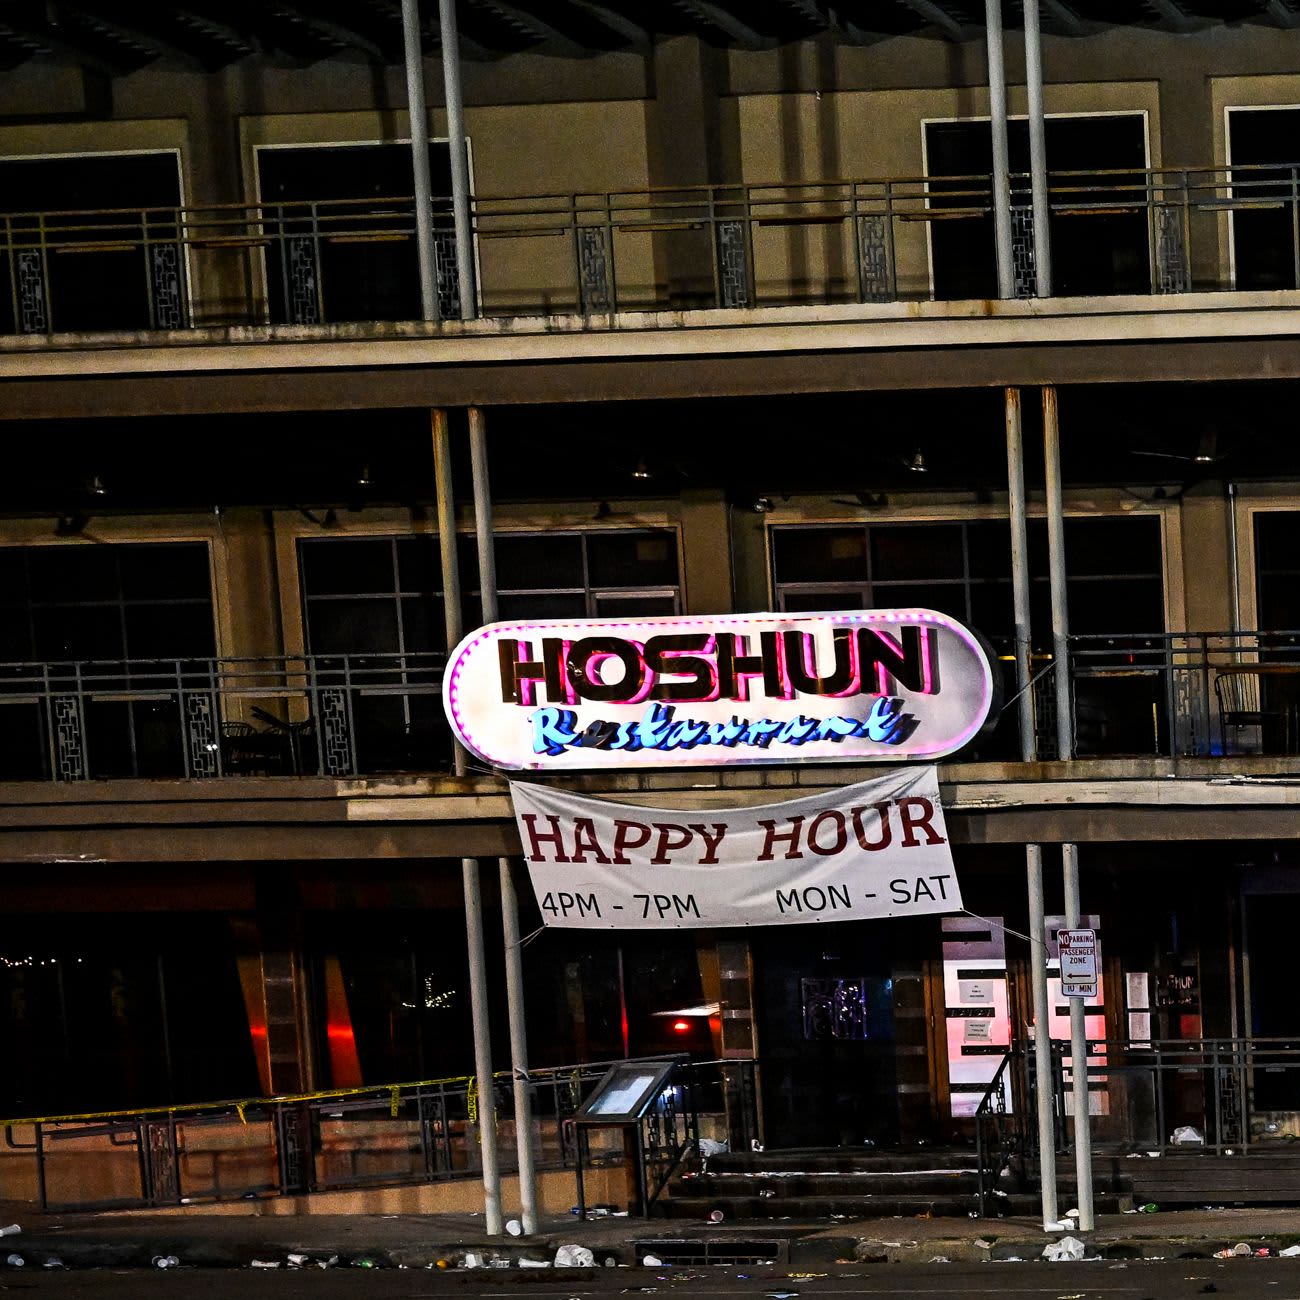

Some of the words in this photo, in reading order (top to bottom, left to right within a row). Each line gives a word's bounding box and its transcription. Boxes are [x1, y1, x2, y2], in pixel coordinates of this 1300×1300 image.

[497, 626, 938, 705] HOSHUN
[529, 697, 914, 755] Restaurant
[521, 812, 728, 866] HAPPY
[756, 796, 945, 862] HOUR
[542, 891, 600, 918] 4PM
[632, 893, 701, 919] 7PM
[775, 883, 853, 914] MON
[889, 874, 951, 905] SAT
[1059, 934, 1069, 945] NO
[1069, 935, 1094, 943] PARKING
[1069, 956, 1087, 964] ZONE
[1078, 984, 1092, 992] MIN
